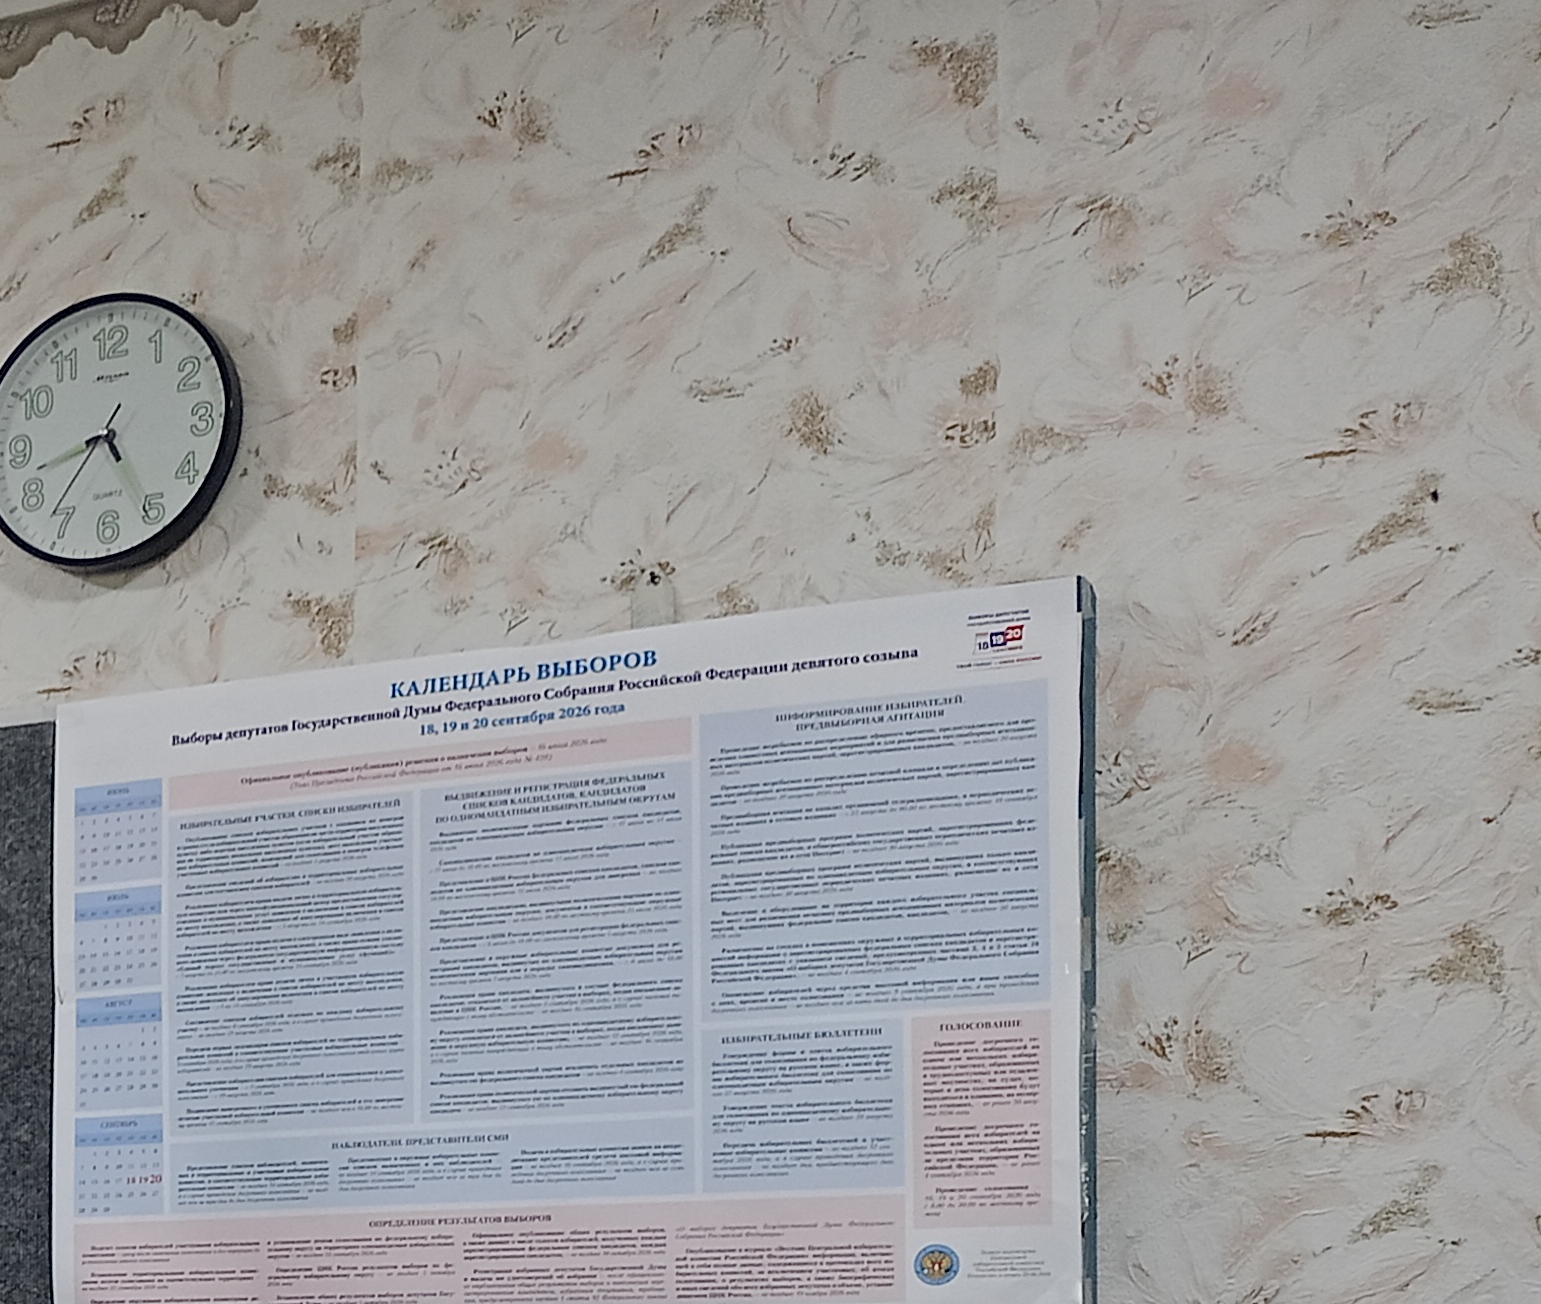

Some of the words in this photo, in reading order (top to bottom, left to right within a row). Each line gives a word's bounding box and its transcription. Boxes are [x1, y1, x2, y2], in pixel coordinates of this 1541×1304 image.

[93, 326, 129, 360] 12
[149, 330, 163, 363] 1
[51, 348, 77, 382] 11
[177, 356, 201, 392] 2
[19, 384, 54, 420] 10
[190, 401, 214, 436] 3
[9, 434, 32, 469] 9
[175, 450, 198, 485] 4
[21, 478, 45, 512] 8
[141, 492, 165, 525] 5
[53, 506, 76, 539] 7
[96, 510, 120, 544] 6
[390, 662, 531, 699] КАЛЕНДАРЬ
[536, 648, 658, 682] ВЫБОРОВ
[172, 730, 223, 747] Выборы
[225, 723, 288, 742] депутатов
[292, 707, 401, 732] Государственной
[403, 701, 442, 720] Думы
[444, 690, 541, 712] Федерального
[544, 679, 615, 702] Собрания
[618, 670, 702, 694] Российской
[705, 660, 788, 685] Федерации
[792, 654, 860, 676] девятого
[863, 646, 919, 663] созыва
[420, 723, 439, 738] 18,
[443, 721, 458, 734] 19
[460, 721, 470, 731] и
[472, 717, 488, 730] 20
[491, 709, 555, 728] сентября
[559, 705, 591, 719] 2026
[594, 701, 625, 718] года
[939, 1019, 1023, 1031] ГОЛОСОВАНИЕ
[126, 1175, 136, 1186] 18
[138, 1174, 149, 1185] 19
[150, 1174, 162, 1184] 20
